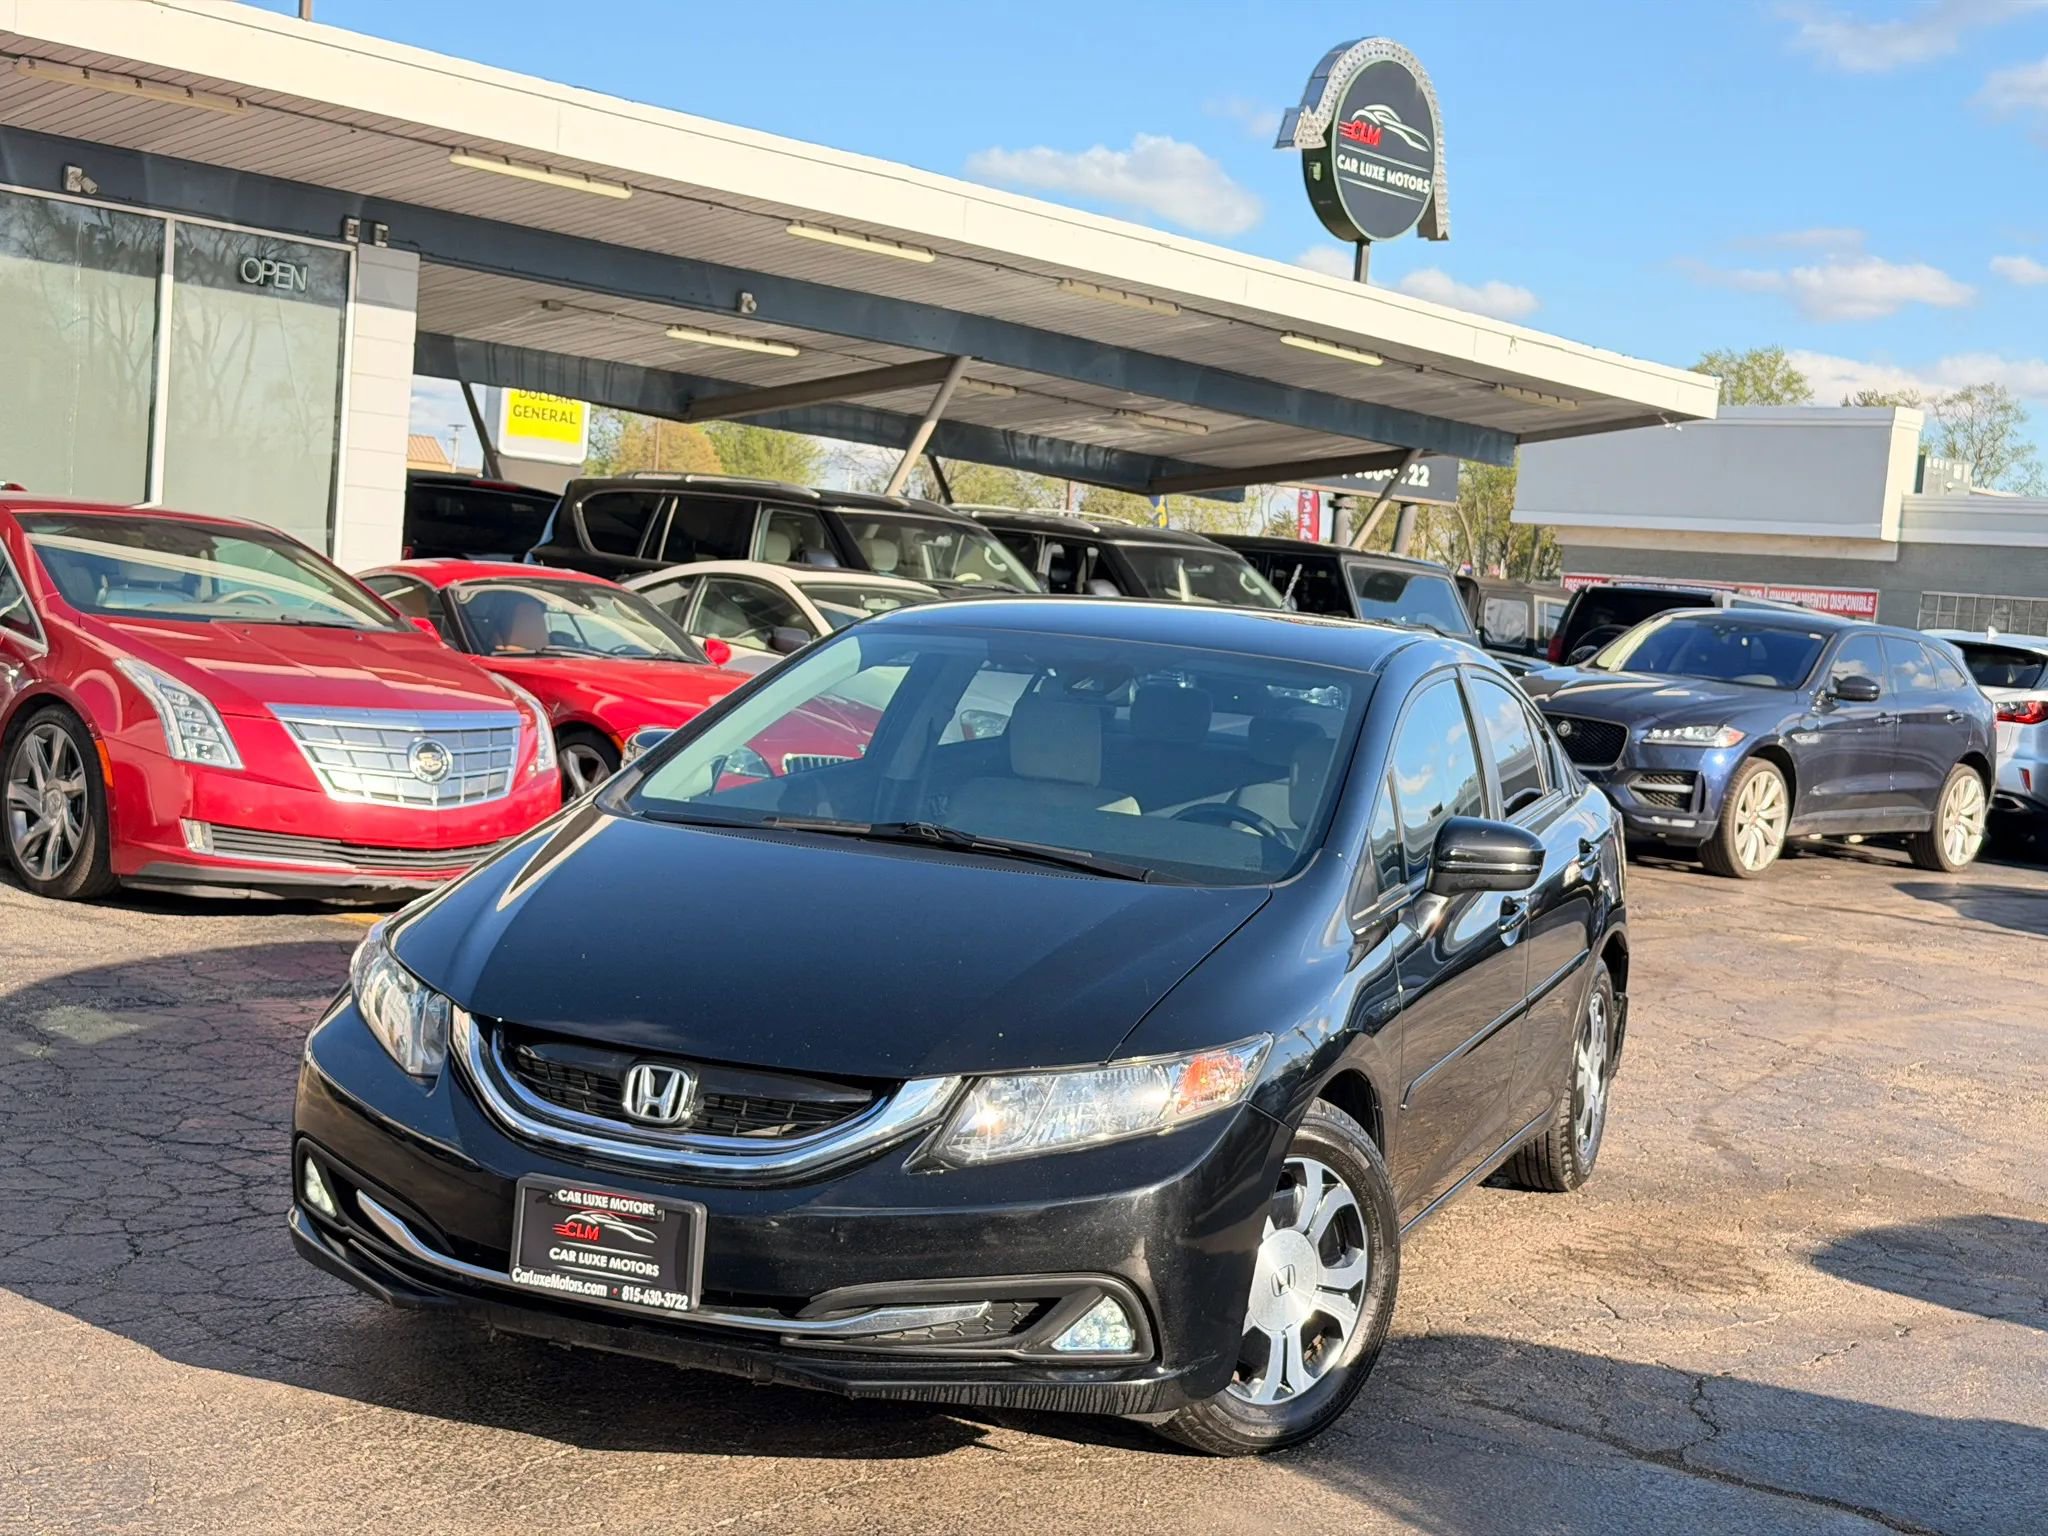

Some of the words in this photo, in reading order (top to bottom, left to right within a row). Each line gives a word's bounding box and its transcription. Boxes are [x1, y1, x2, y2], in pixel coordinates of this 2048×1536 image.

[1351, 119, 1382, 149] CLM
[1337, 154, 1358, 173] CAR
[1359, 161, 1385, 182] LUXE
[1387, 169, 1431, 194] MOTORS
[241, 257, 308, 291] OPEN
[513, 404, 577, 425] GENERAL
[557, 1189, 583, 1205] CAR
[583, 1193, 609, 1208] LUXE
[610, 1197, 656, 1216] MOTORS
[565, 1221, 600, 1241] CLM
[549, 1247, 576, 1262] CAR
[578, 1252, 607, 1268] LUXE
[609, 1257, 660, 1278] MOTORS
[511, 1267, 608, 1298] CarLuxeMotors.com
[621, 1284, 689, 1311] 815-630-3722
